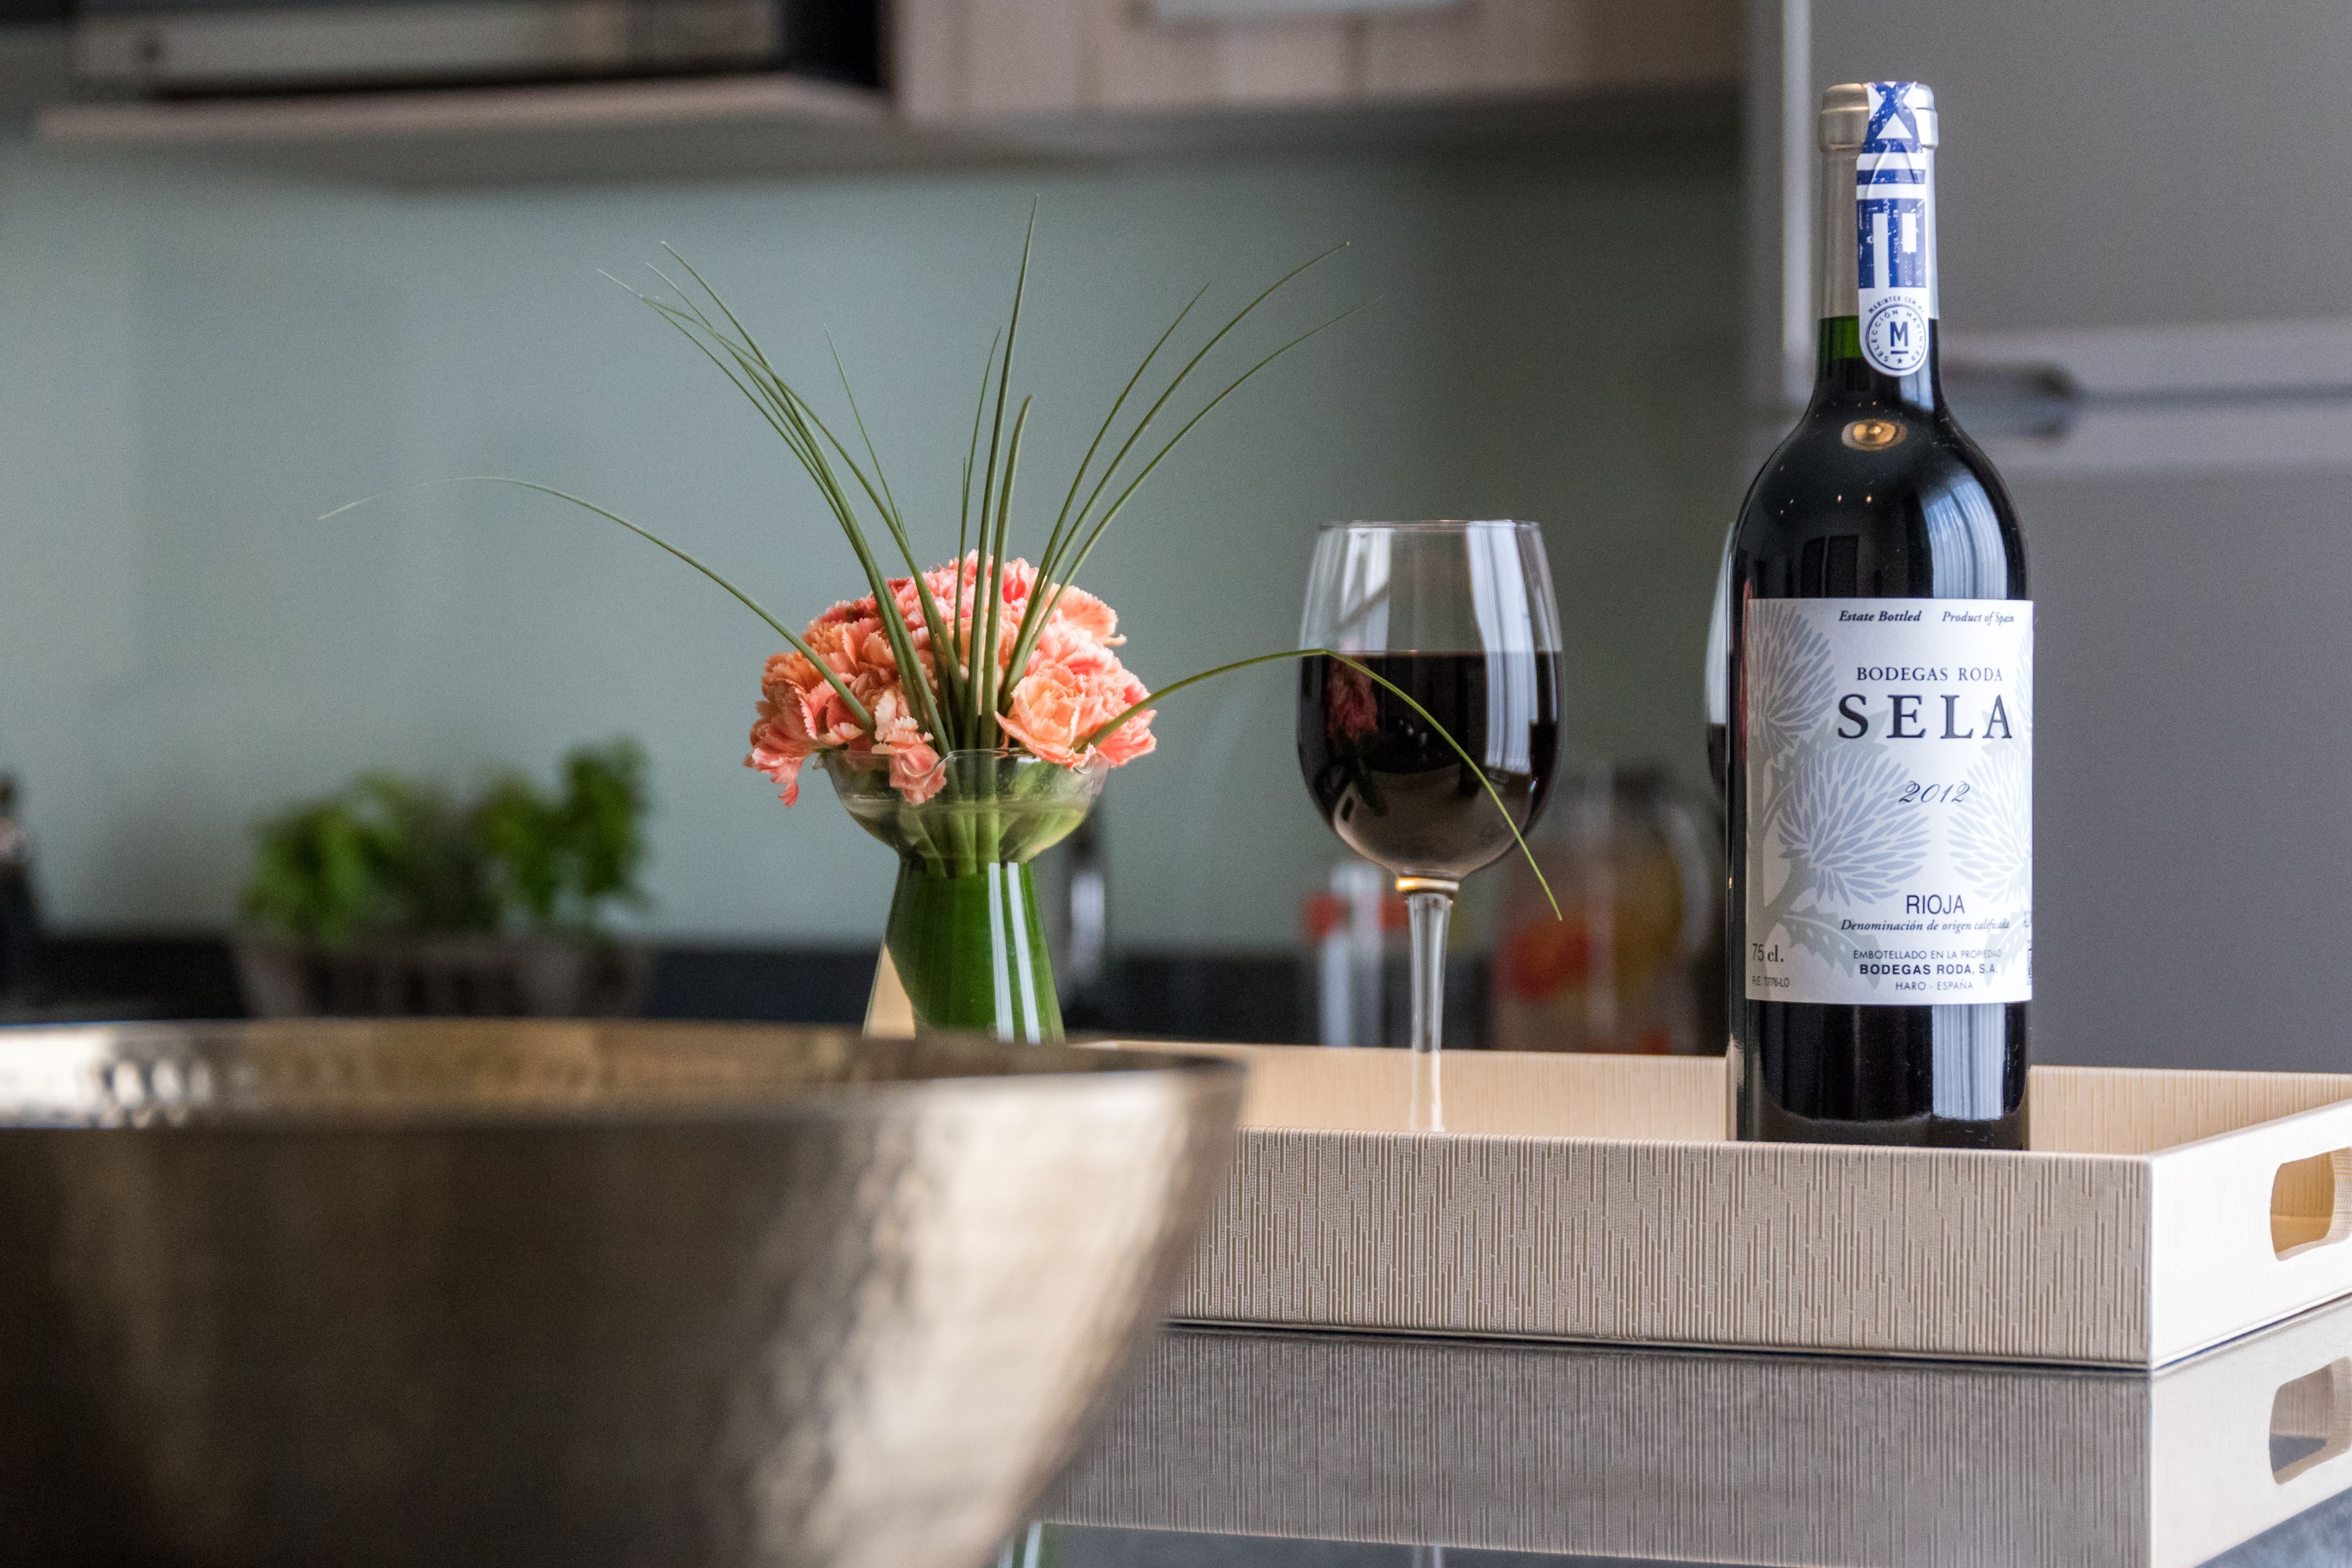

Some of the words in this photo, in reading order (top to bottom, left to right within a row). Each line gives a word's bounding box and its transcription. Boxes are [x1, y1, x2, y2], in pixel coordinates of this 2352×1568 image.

[1871, 309, 1898, 362] SELECCIÓN
[1890, 321, 1909, 347] M
[1839, 610, 1875, 622] Estate
[1878, 610, 1923, 622] Bottled
[1942, 611, 1982, 622] Product
[1985, 611, 1994, 625] of
[1995, 612, 2015, 625] Spain
[1856, 666, 1948, 682] BODEGAS
[1958, 666, 2003, 682] RODA
[1837, 693, 2013, 740] SELA
[1898, 780, 1971, 804] 2012
[1906, 894, 1965, 914] RIOJA
[1841, 919, 1923, 931] Denominación
[1926, 919, 1939, 931] de
[1942, 921, 1972, 933] origen
[1974, 919, 2010, 934] calificada
[1752, 943, 1765, 962] 75
[1767, 944, 1784, 962] cl.
[1853, 949, 1927, 960] EMBOTELLADO
[1931, 950, 1943, 959] EN
[1947, 950, 1958, 959] LA
[1961, 949, 2002, 959] PROPIEDAD
[1860, 964, 1931, 975] BODEGAS
[1937, 964, 1975, 976] RODA,
[1979, 963, 1998, 974] S.A.
[1895, 981, 1926, 991] HARO
[1937, 978, 1973, 991] ESPAÑA
